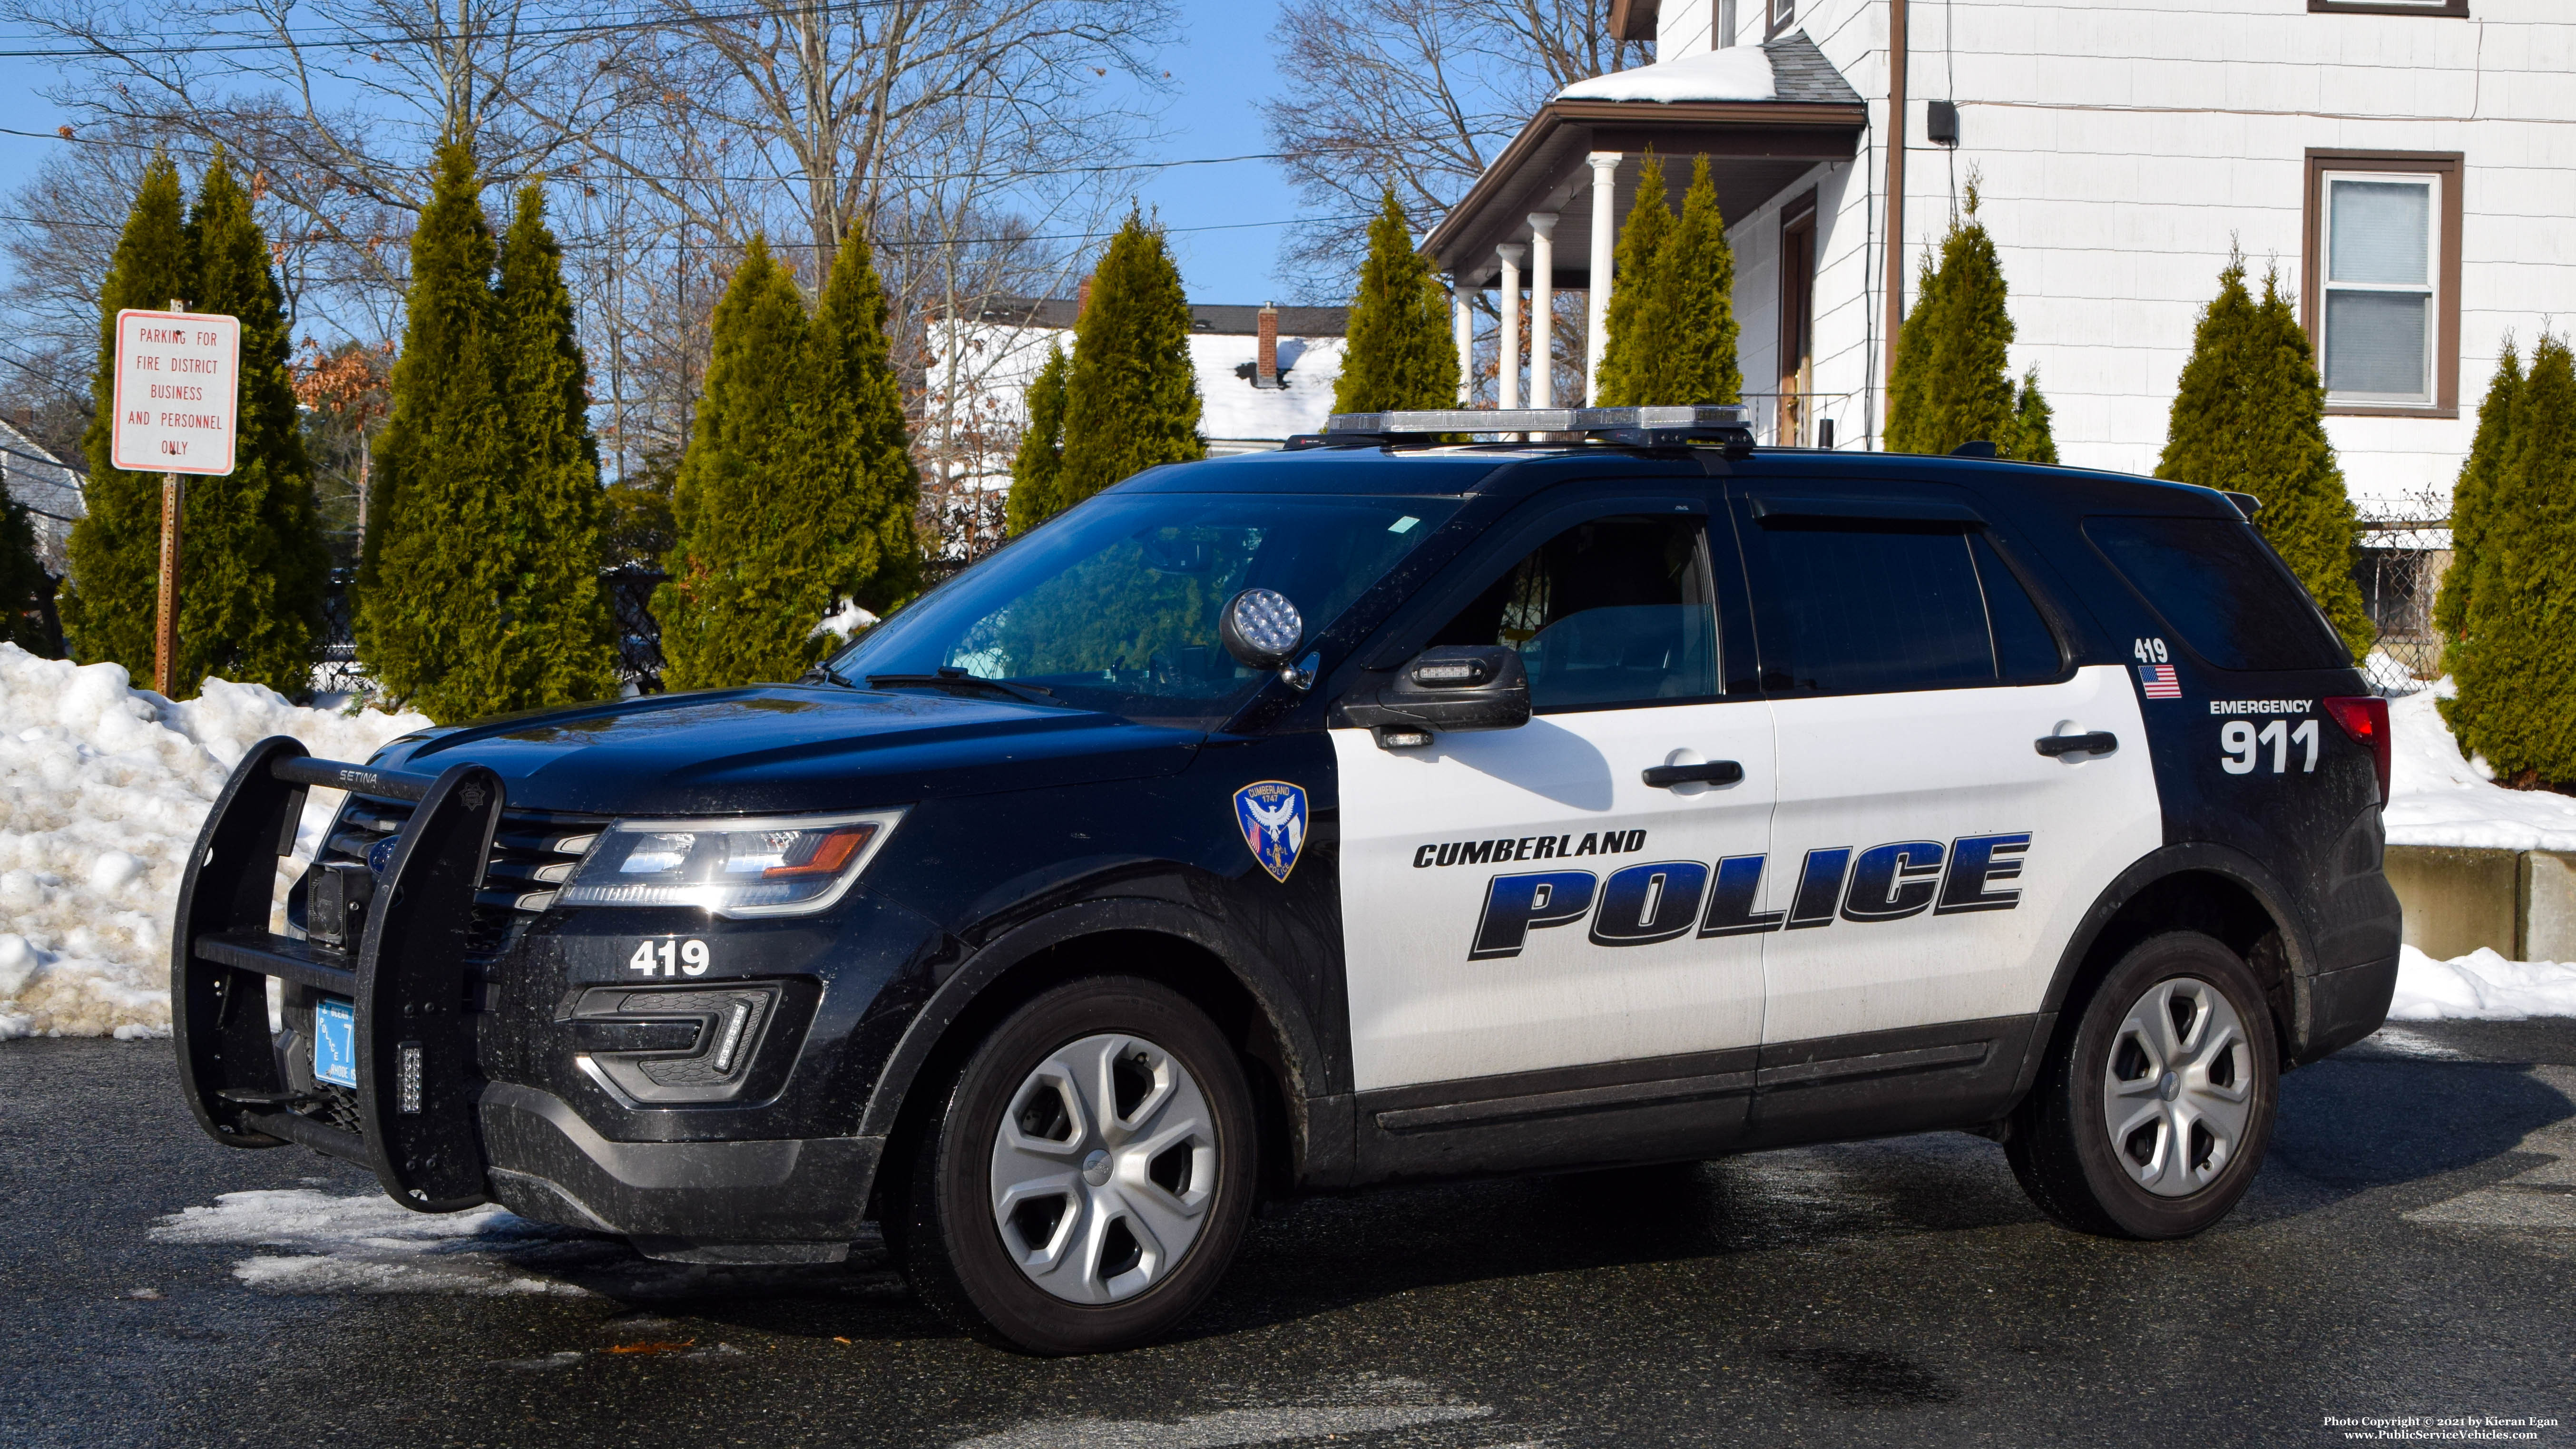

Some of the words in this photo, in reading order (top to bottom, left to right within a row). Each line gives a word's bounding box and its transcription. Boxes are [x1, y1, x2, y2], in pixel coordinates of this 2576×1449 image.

[140, 328, 186, 344] PARKING
[197, 332, 217, 346] FOR
[137, 356, 160, 371] FIRE
[171, 358, 217, 374] DISTRICT
[151, 384, 202, 401] BUSINESS
[128, 411, 150, 425] AND
[161, 413, 222, 430] PERSONNEL
[161, 441, 188, 455] ONLY
[2134, 638, 2168, 663] 419
[2210, 700, 2312, 714] EMERGENCY
[2221, 720, 2318, 775] 911
[340, 770, 377, 784] SETINA
[1248, 785, 1290, 798] CUMBERLAND
[1412, 829, 1647, 868] CUMBERLAND
[1269, 862, 1290, 876] POLICE
[1467, 831, 2033, 962] POLICE
[630, 940, 709, 976] 419
[331, 1007, 348, 1020] OCEAN
[320, 1018, 339, 1061] POLICE
[331, 1064, 348, 1079] RHODE
